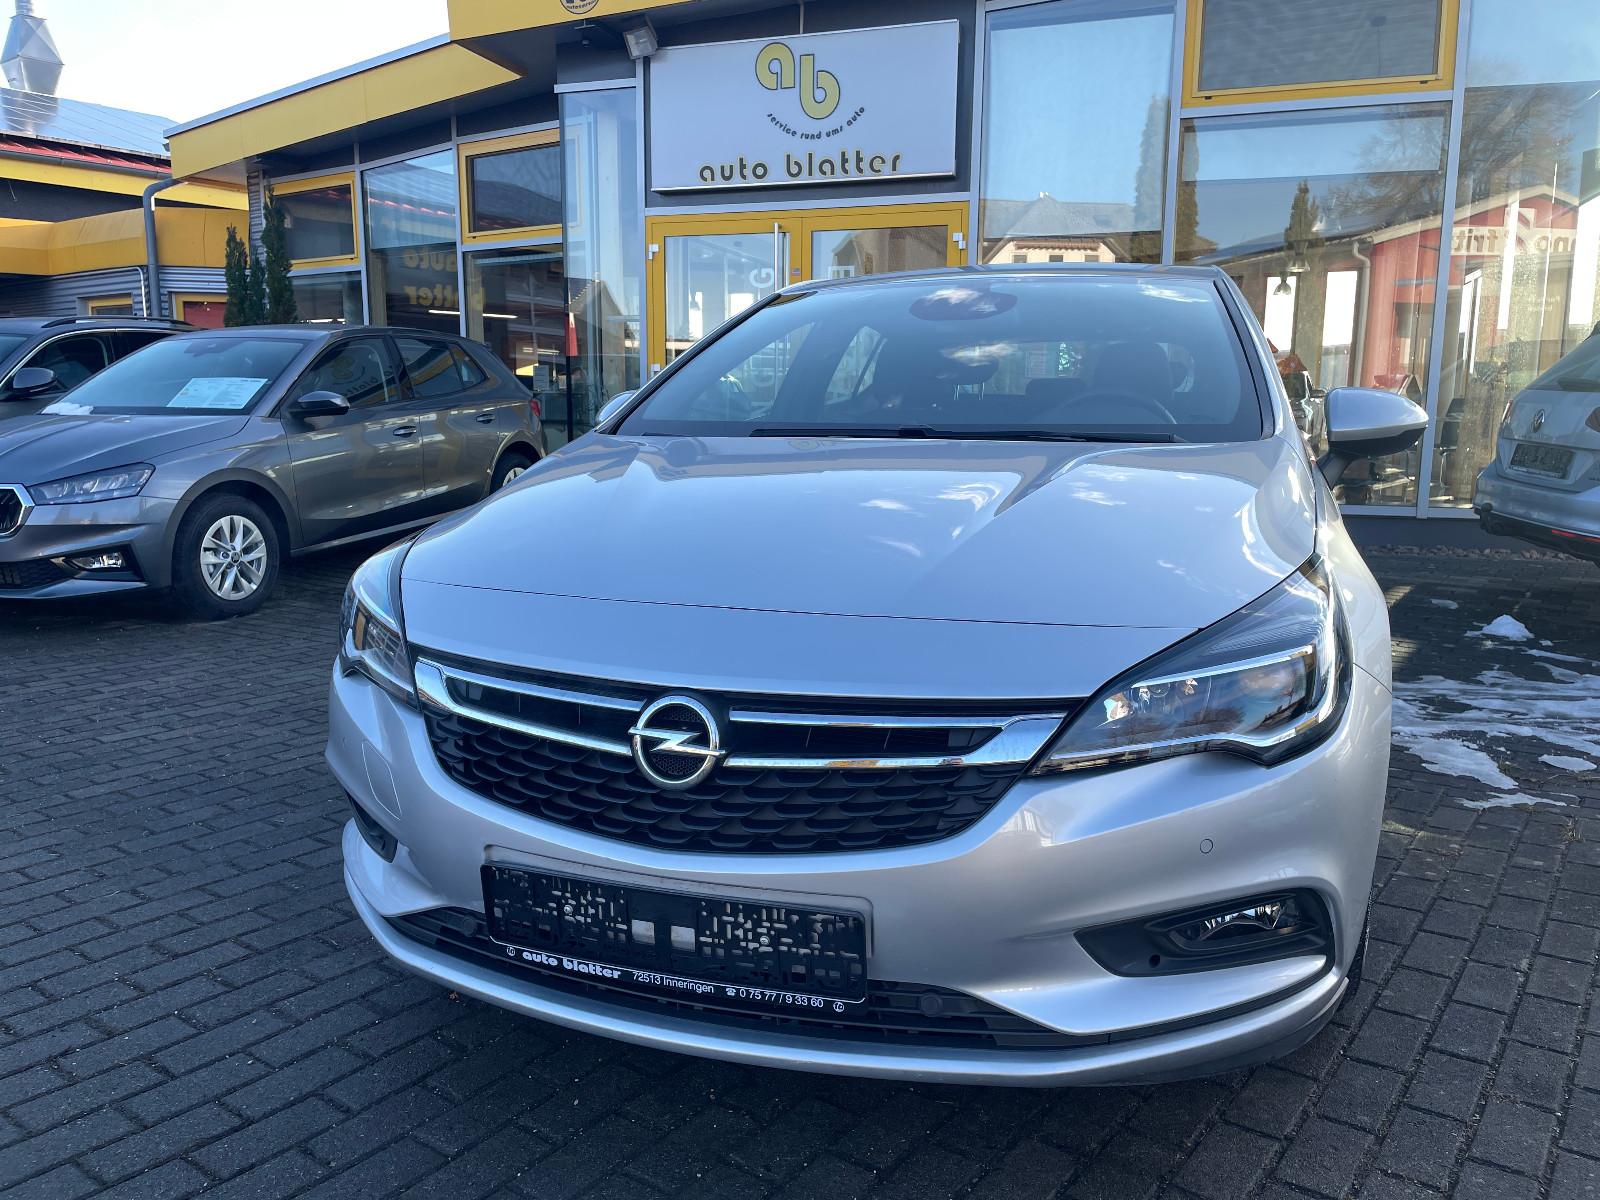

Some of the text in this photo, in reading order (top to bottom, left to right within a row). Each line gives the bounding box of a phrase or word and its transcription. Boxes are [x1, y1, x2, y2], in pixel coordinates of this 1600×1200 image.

[766, 106, 865, 140] service rund ums auto
[698, 149, 901, 183] auto blatter
[522, 950, 558, 966] auto
[562, 957, 622, 979] blatter
[632, 970, 662, 985] 72513
[663, 976, 715, 994] Inneringen
[739, 988, 747, 998] 0
[749, 989, 762, 1000] 75
[764, 991, 777, 1002] 77
[785, 994, 793, 1004] 9
[794, 996, 809, 1006] 33
[810, 997, 824, 1008] 60
